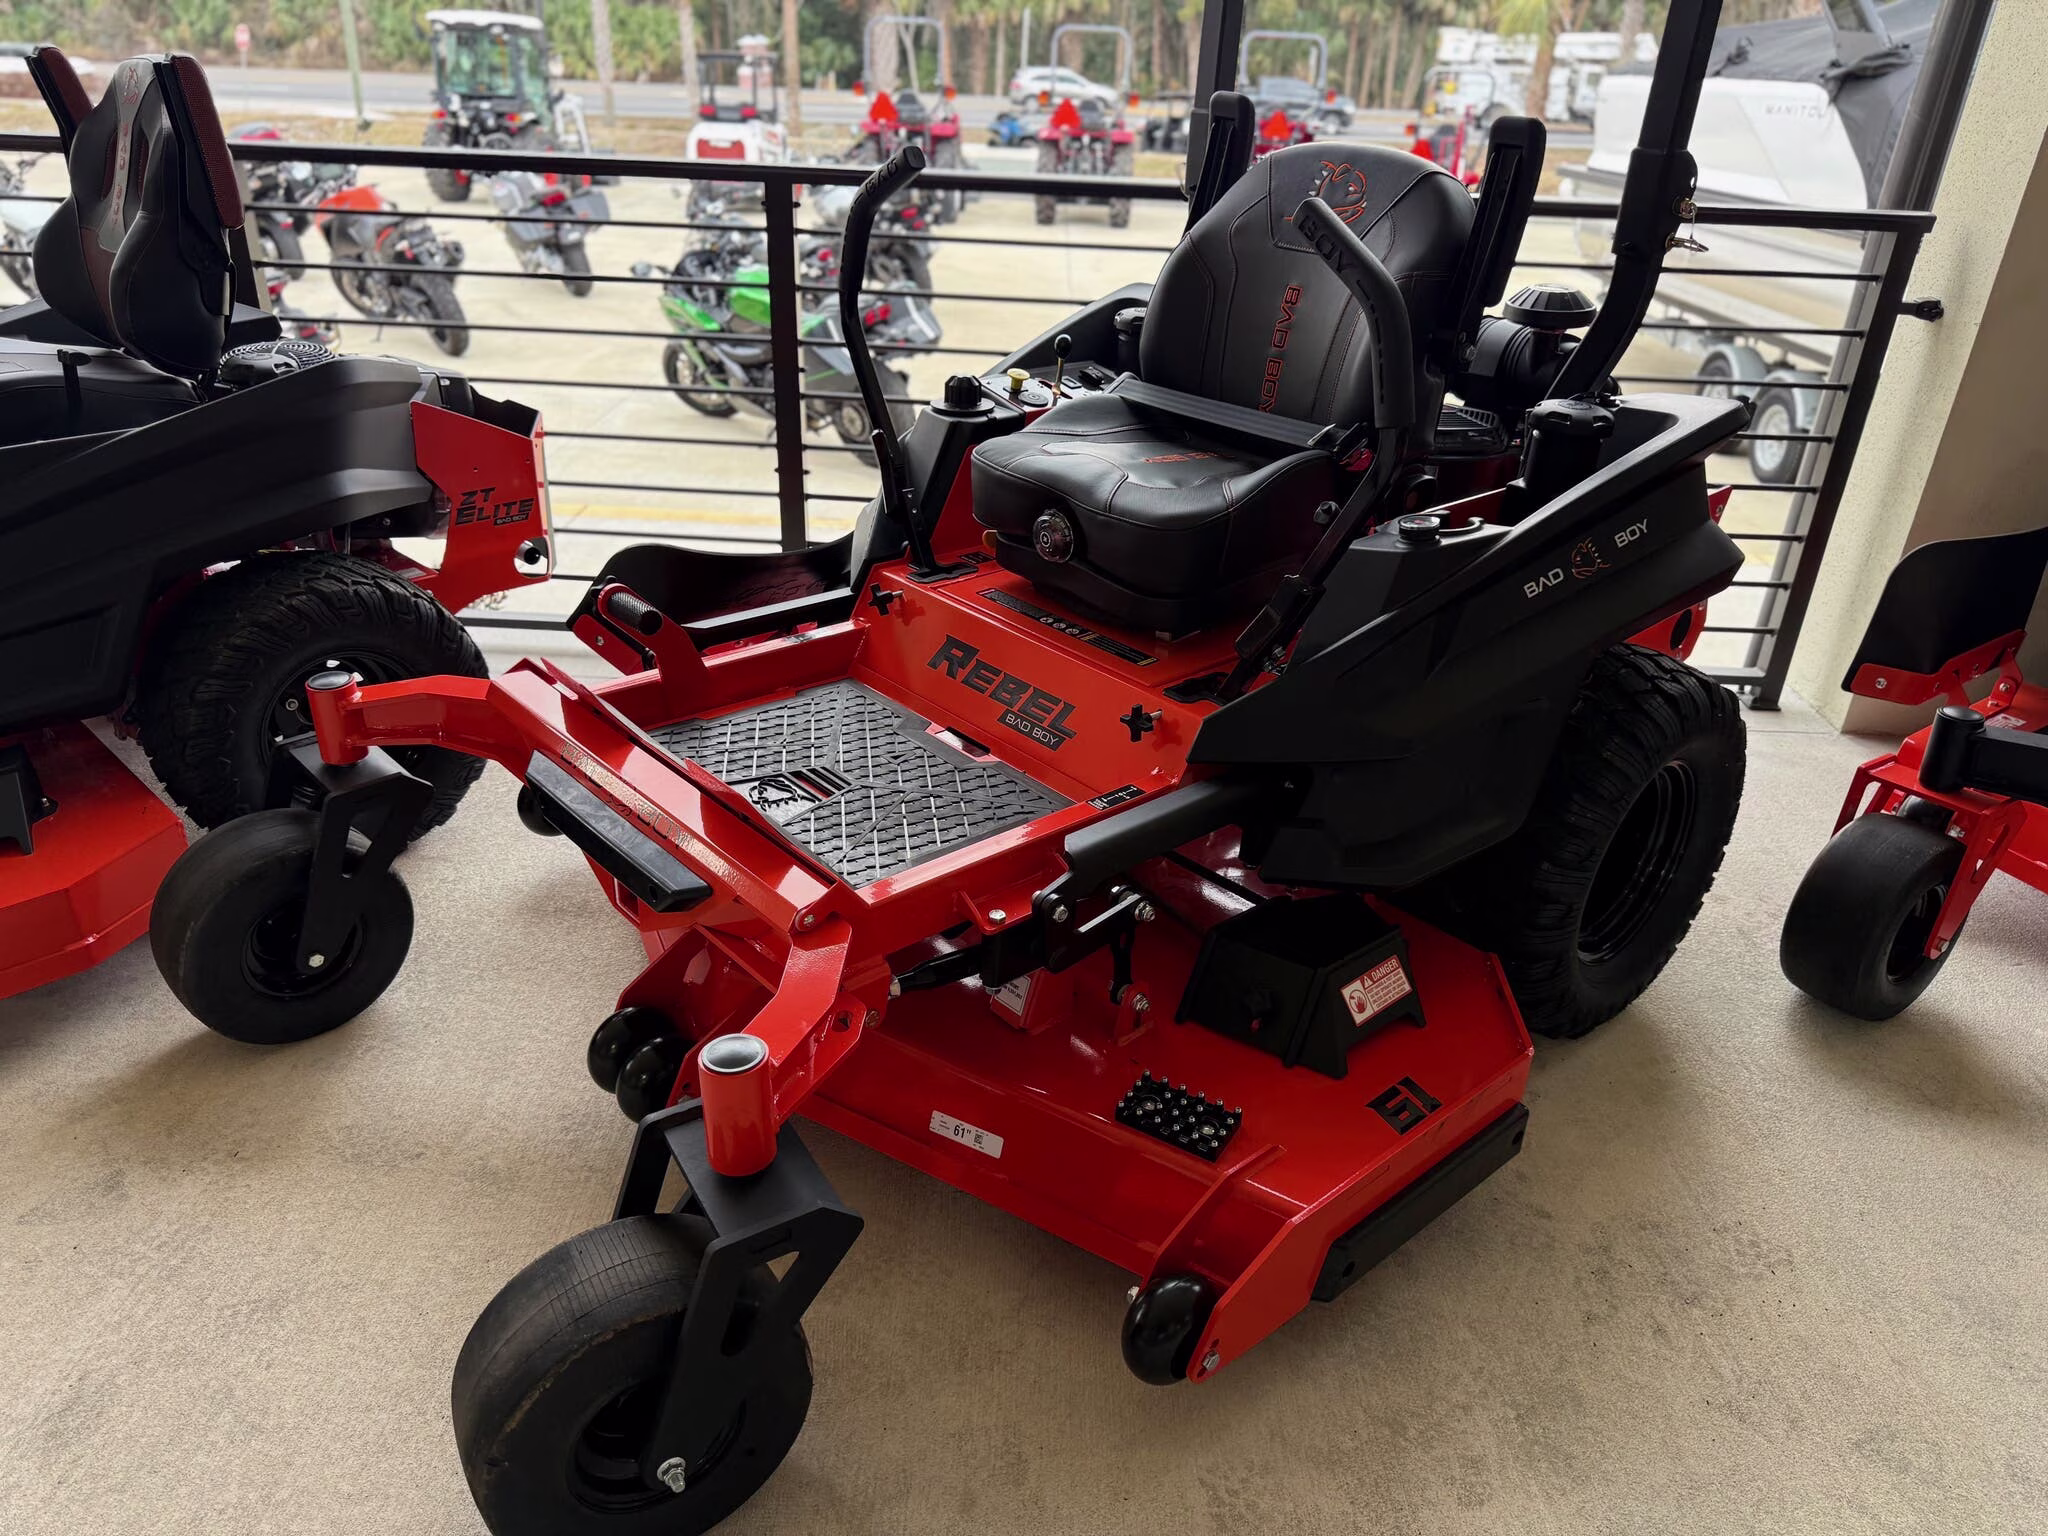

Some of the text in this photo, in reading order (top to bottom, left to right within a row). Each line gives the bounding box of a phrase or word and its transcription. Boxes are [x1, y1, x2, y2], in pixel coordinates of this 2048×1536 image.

[1298, 214, 1358, 274] BOY
[1271, 284, 1303, 349] BAD
[455, 497, 535, 526] ELITE
[460, 487, 497, 507] ZT
[1523, 518, 1648, 598] BAD BOY
[926, 633, 1077, 739] REBEL
[1005, 713, 1059, 745] BAD BOY
[1371, 958, 1399, 981] DANGER
[1364, 1075, 1443, 1134] 61
[953, 1124, 972, 1139] 61"
